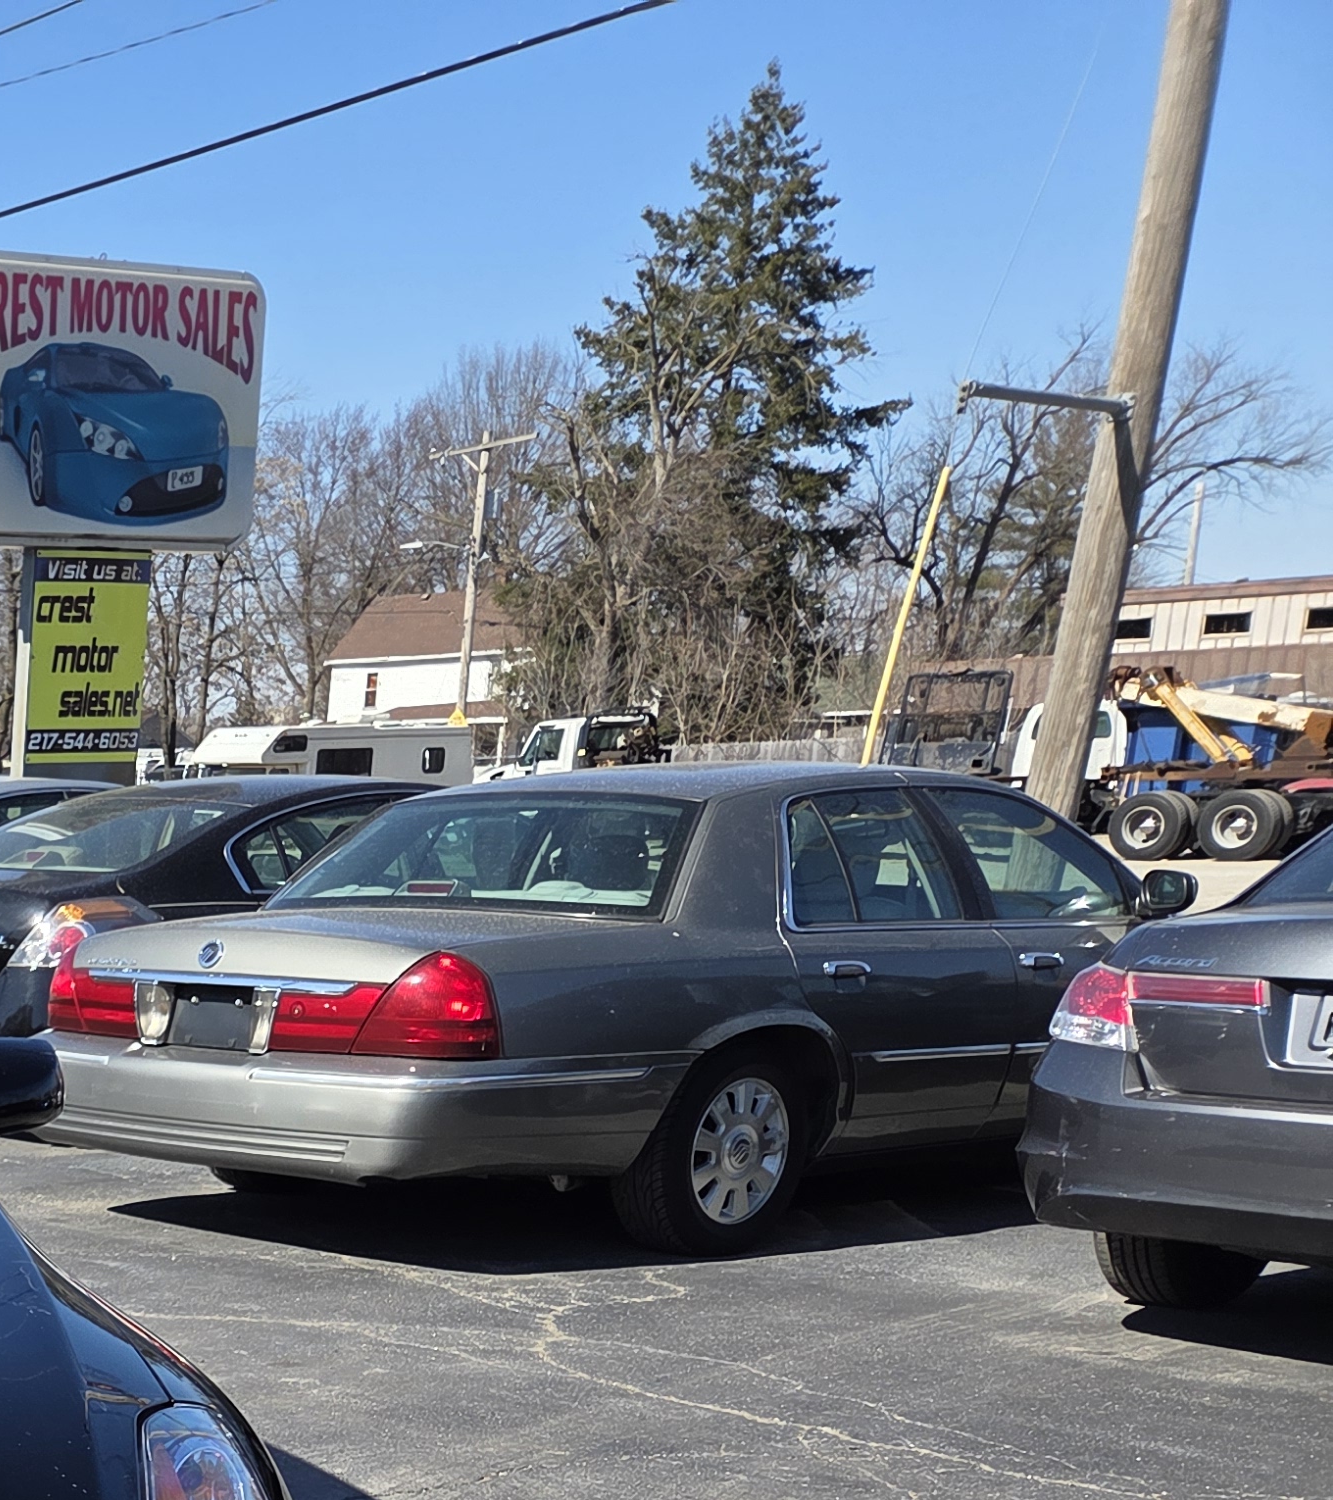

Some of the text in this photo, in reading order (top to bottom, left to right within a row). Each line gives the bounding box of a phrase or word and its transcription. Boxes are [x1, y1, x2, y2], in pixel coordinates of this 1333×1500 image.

[70, 278, 169, 341] MOTOR
[177, 286, 258, 384] SALES
[48, 560, 141, 580] Visit us at:
[36, 587, 95, 623] crest
[52, 637, 119, 673] motor
[58, 682, 140, 718] sales.net
[28, 732, 139, 750] 217-544-6053
[1135, 954, 1219, 968] Accord
